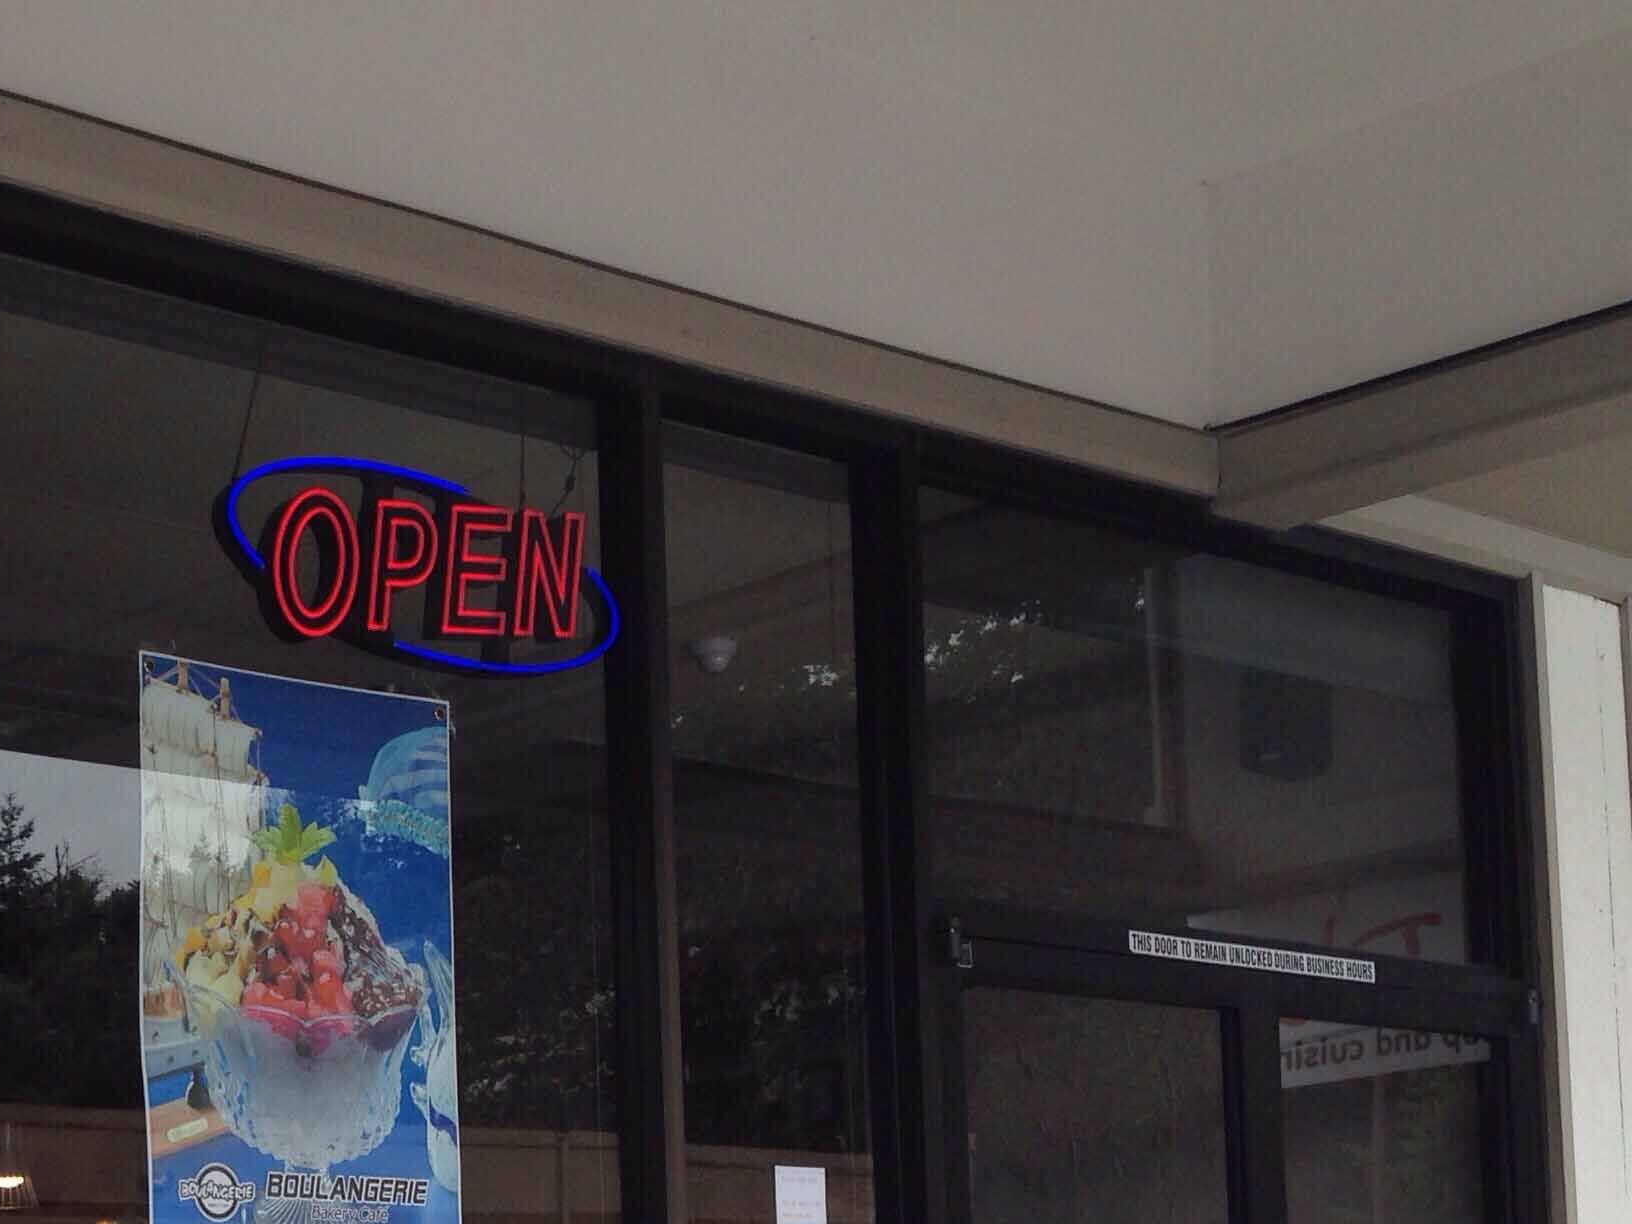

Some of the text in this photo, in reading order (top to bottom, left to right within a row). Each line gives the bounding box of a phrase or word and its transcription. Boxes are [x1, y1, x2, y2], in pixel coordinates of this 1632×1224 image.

[272, 486, 586, 638] OPEN
[1131, 933, 1373, 980] THIS DOOR TO REMAIN UNLOCKED DURING BUSINESS HOURS
[267, 1173, 428, 1204] BOULANGERIE
[311, 1205, 358, 1223] Bakery
